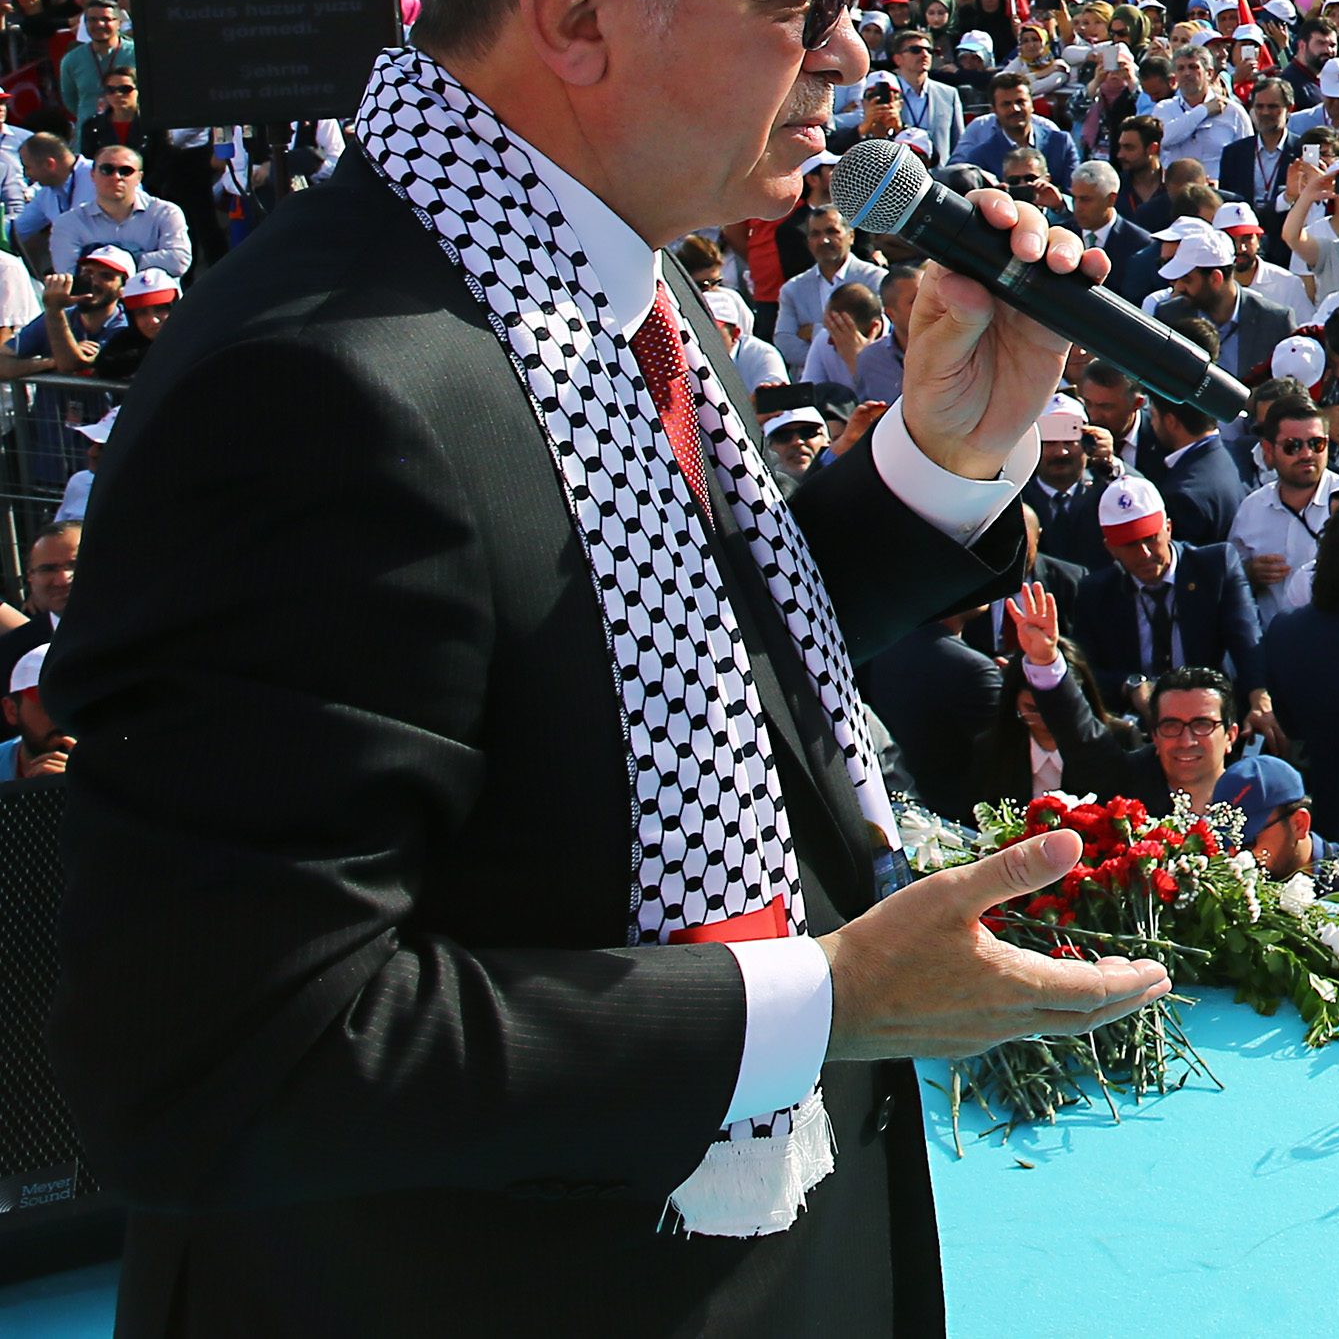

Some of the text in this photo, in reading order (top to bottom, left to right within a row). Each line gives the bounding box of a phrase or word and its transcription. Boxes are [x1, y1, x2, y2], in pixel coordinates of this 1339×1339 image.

[167, 2, 238, 20] Kudüs
[245, 1, 306, 17] huzur
[222, 22, 320, 42] görmedi.
[209, 81, 335, 101] tüm dinlere
[22, 1177, 72, 1197] Meyer
[19, 1188, 72, 1209] Sound
